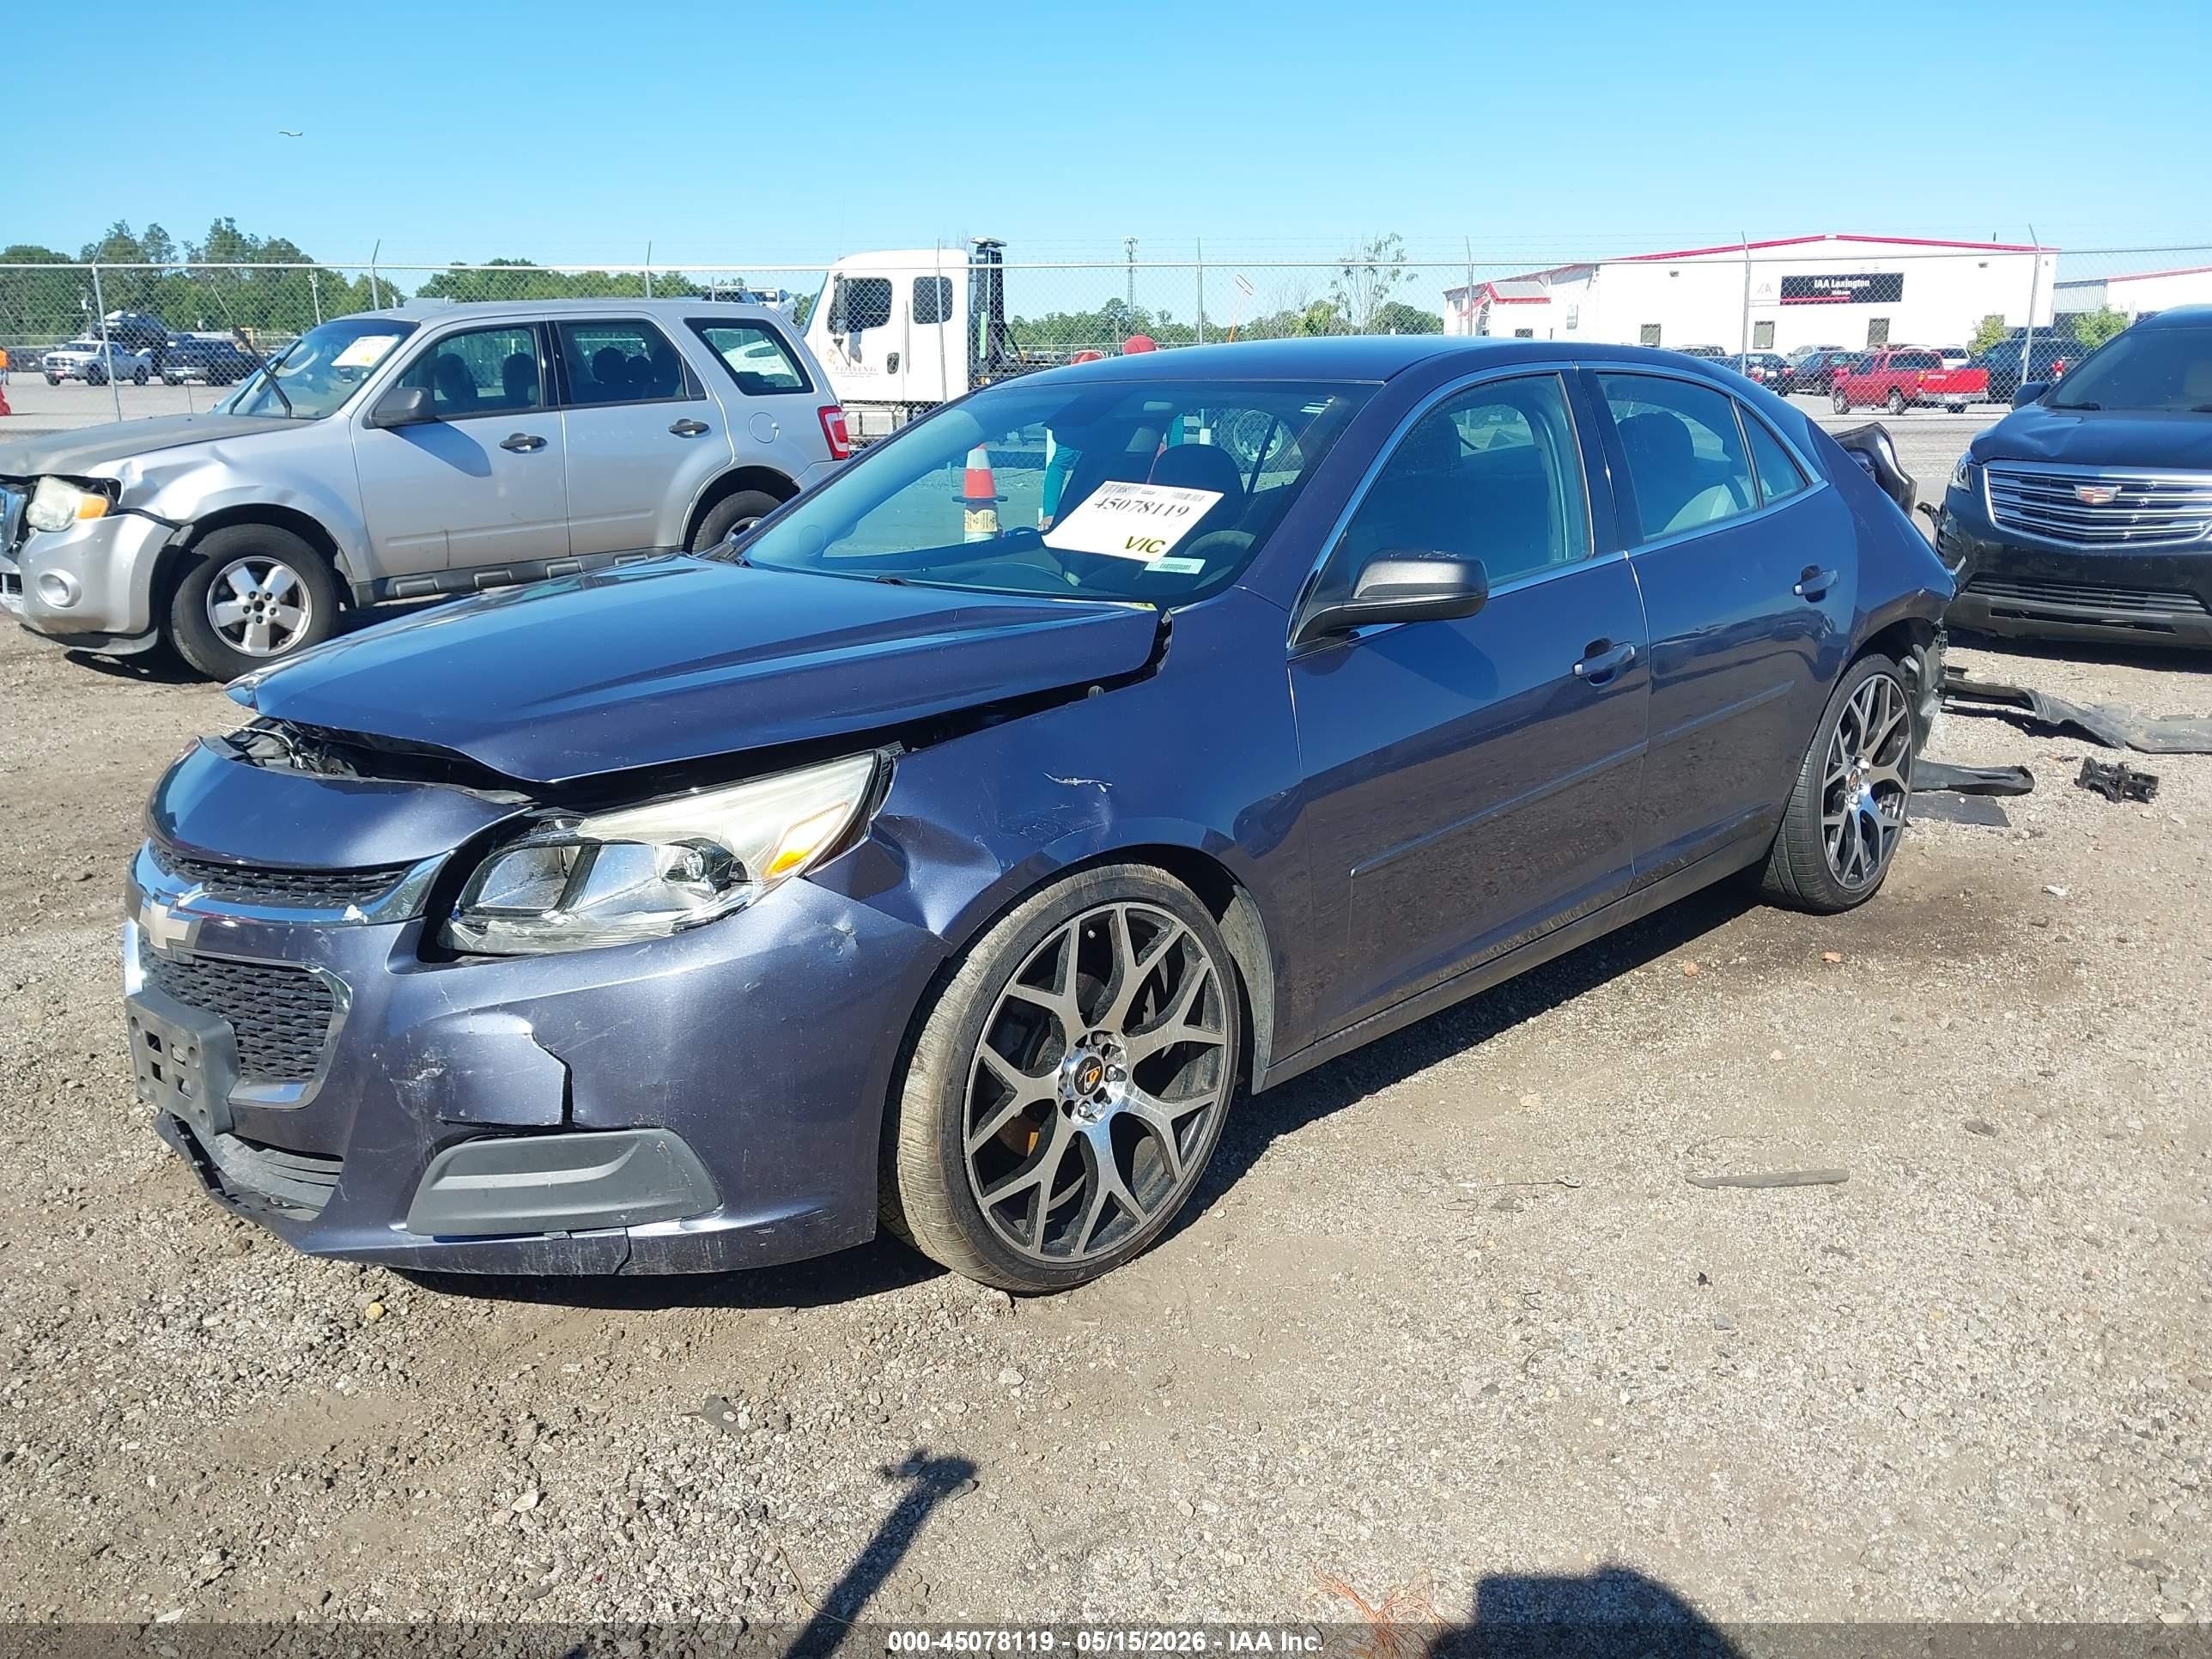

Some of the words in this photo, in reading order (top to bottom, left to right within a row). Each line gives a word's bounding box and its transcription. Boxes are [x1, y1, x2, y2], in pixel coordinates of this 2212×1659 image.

[1814, 279, 1830, 289] IAA
[1831, 278, 1870, 290] Lexington
[1094, 496, 1190, 518] 45078119
[1124, 536, 1166, 554] VIC
